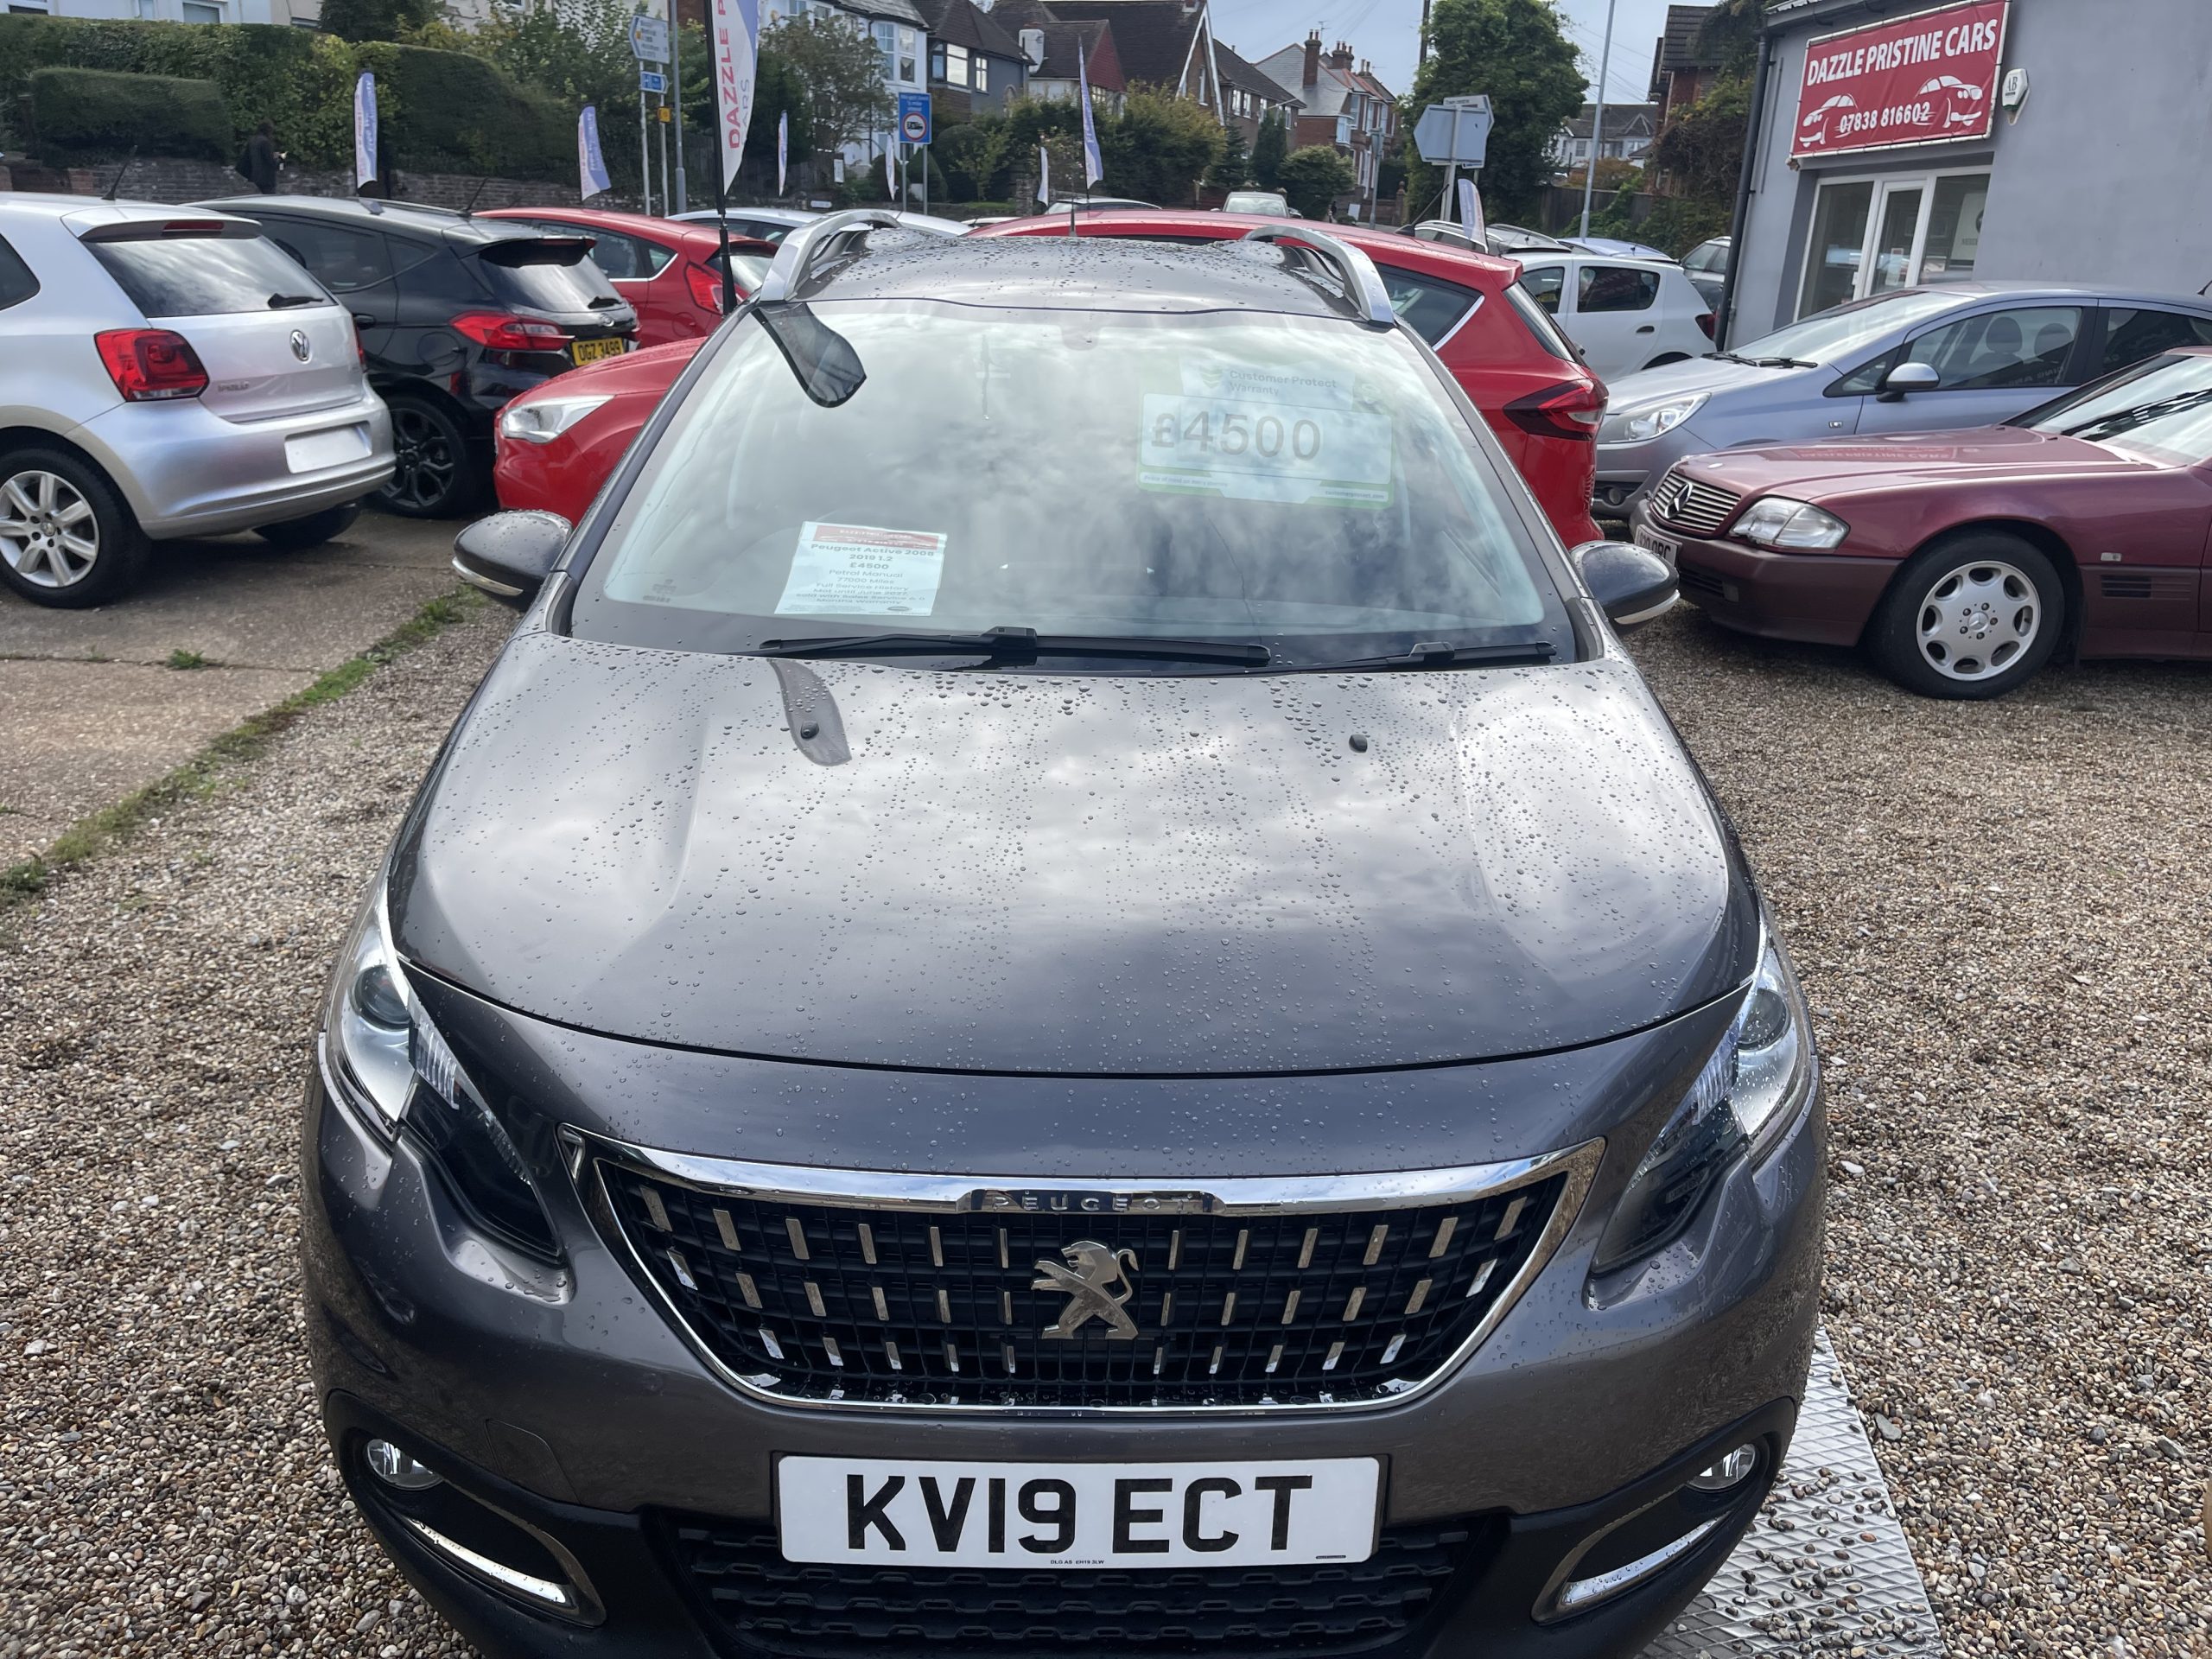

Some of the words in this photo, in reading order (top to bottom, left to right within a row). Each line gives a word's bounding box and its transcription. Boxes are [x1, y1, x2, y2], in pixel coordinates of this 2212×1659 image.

[1807, 48, 1864, 86] DAZZLE
[1865, 30, 1942, 74] PRISTINE
[1944, 19, 1998, 57] CARS
[719, 28, 741, 149] DAZZLE
[1840, 110, 1877, 133] 07838
[1880, 102, 1931, 127] 816602
[578, 343, 597, 360] OGZ
[1230, 370, 1288, 385] Customer
[1291, 377, 1337, 389] Protect
[1230, 383, 1279, 396] Warranty
[1151, 410, 1321, 461] £4500
[810, 543, 861, 552] Peugeot
[994, 1193, 1191, 1211] PEUGEOT
[846, 1474, 1077, 1554] KV19
[1112, 1474, 1313, 1554] ECT
